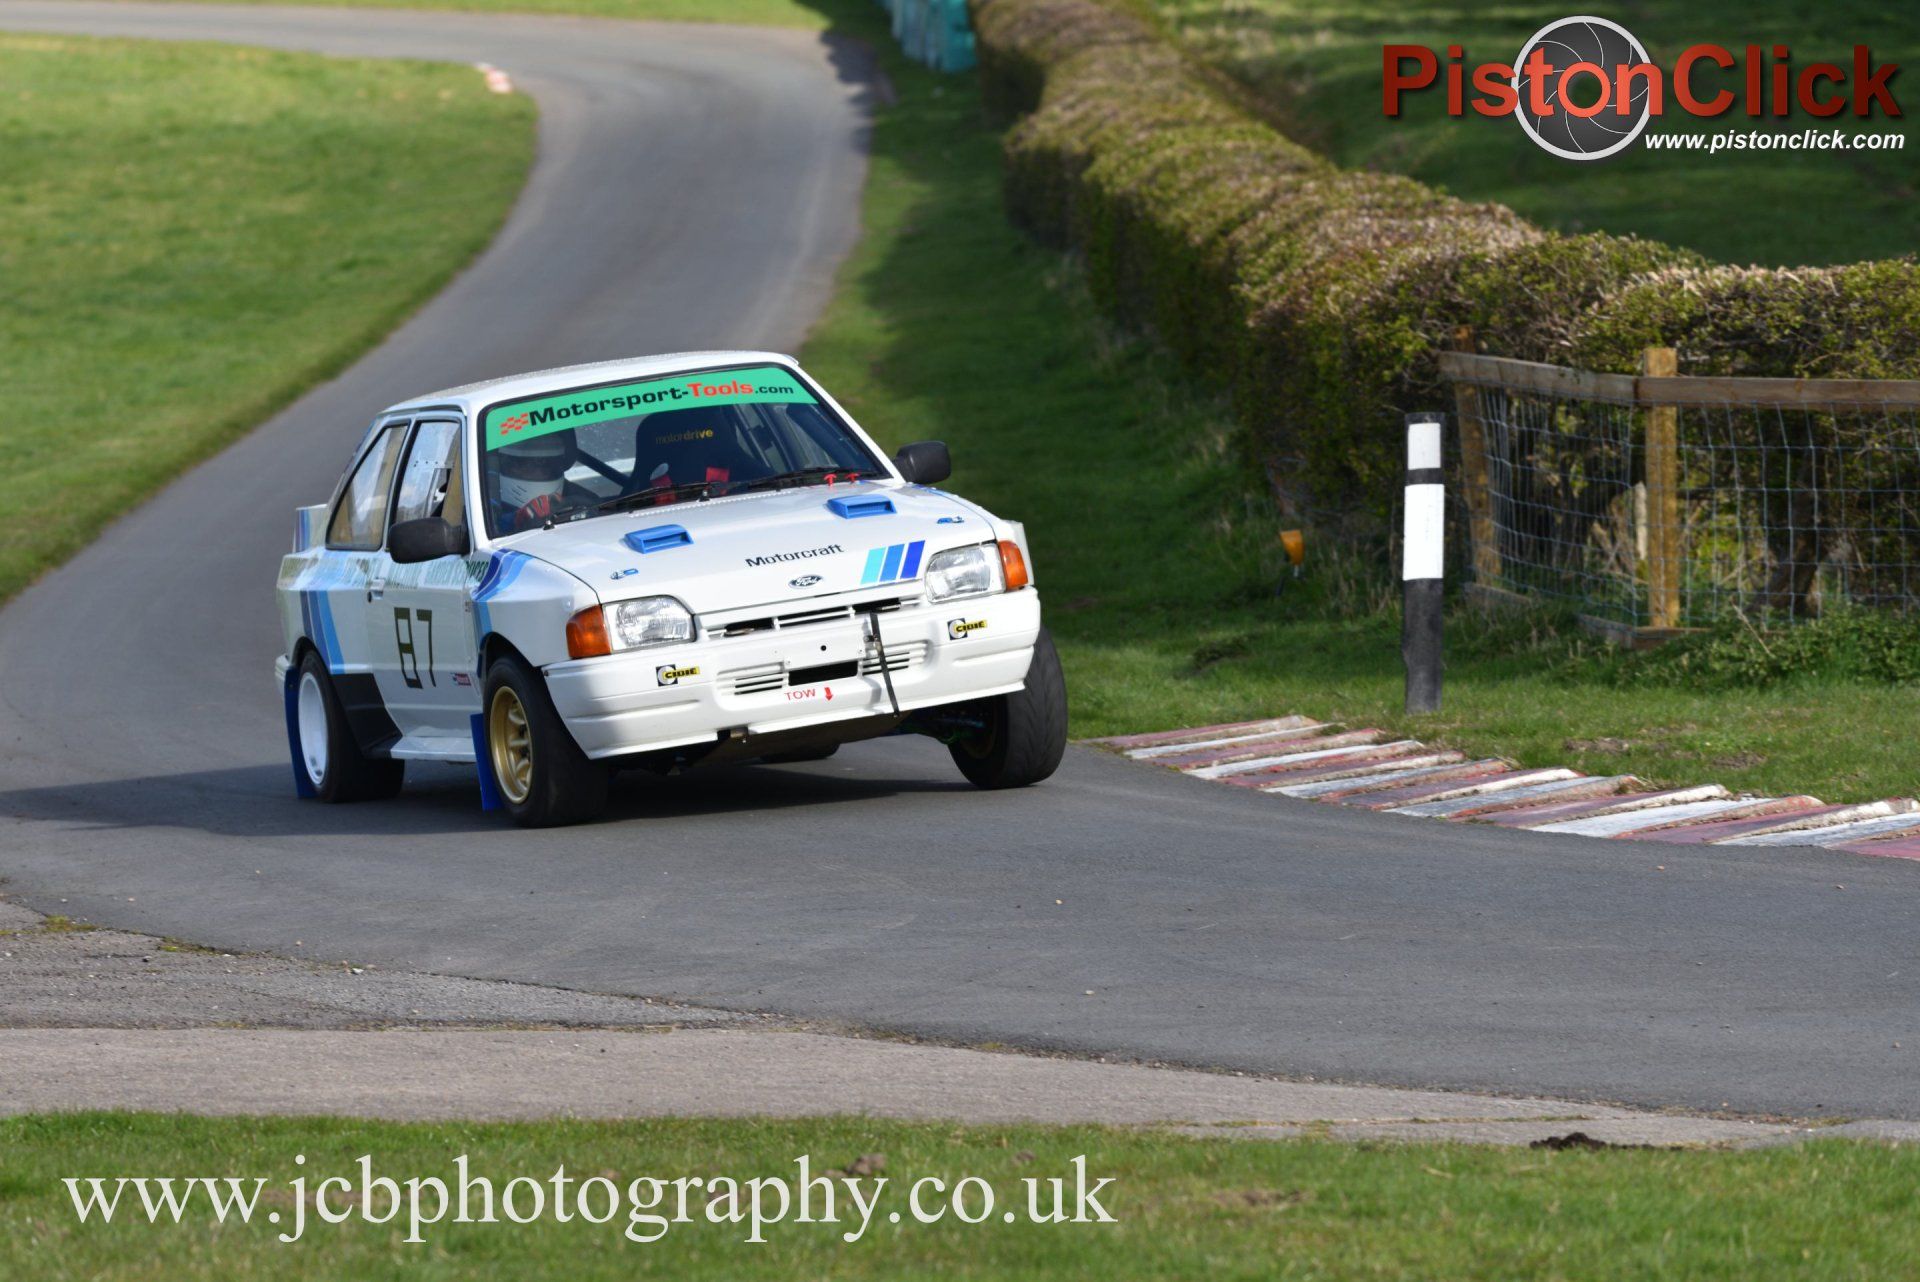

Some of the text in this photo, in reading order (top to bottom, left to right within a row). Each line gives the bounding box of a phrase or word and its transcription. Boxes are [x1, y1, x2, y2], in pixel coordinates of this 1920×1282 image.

[528, 380, 795, 427] Motorsport-Tools.com
[745, 543, 845, 568] Motorcraft
[791, 574, 821, 587] Ford
[394, 607, 437, 690] 87
[784, 687, 817, 701] TOW
